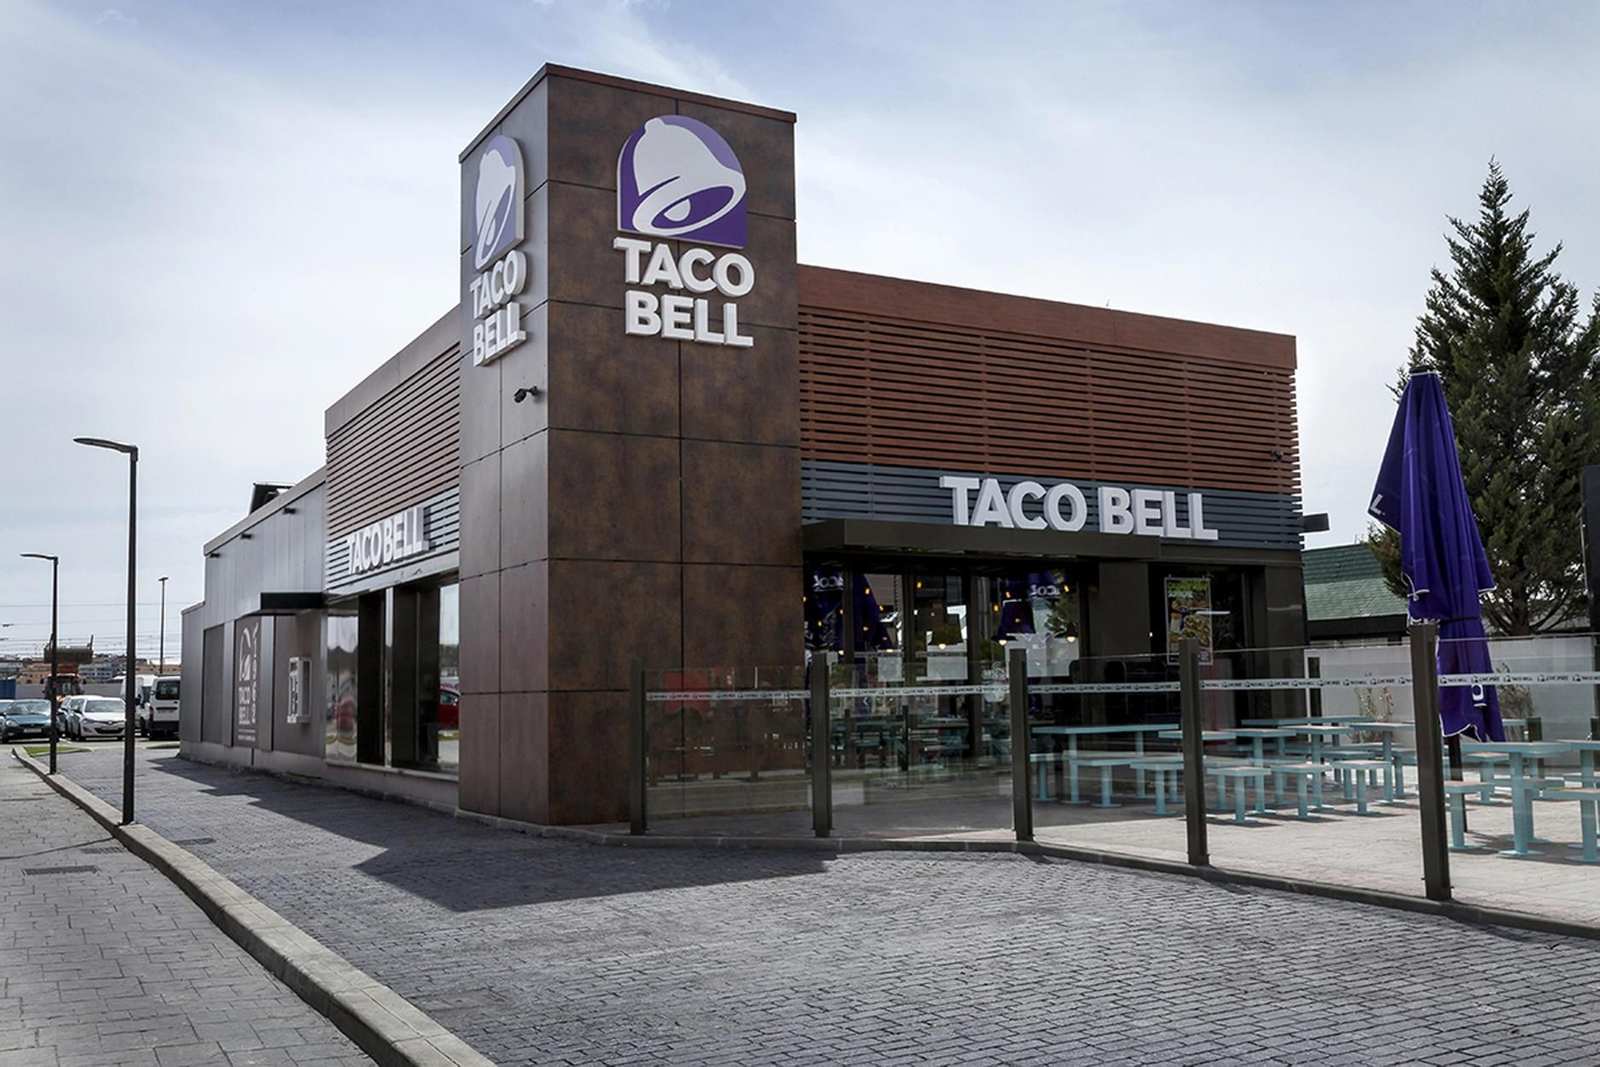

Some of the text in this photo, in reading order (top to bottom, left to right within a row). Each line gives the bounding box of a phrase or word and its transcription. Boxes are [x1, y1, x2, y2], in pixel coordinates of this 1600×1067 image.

[470, 250, 527, 319] TACO
[613, 236, 755, 297] TACO
[473, 301, 527, 367] BELL
[625, 289, 754, 347] BELL
[939, 475, 1218, 540] TACO BELL
[347, 507, 429, 574] TACO BELL
